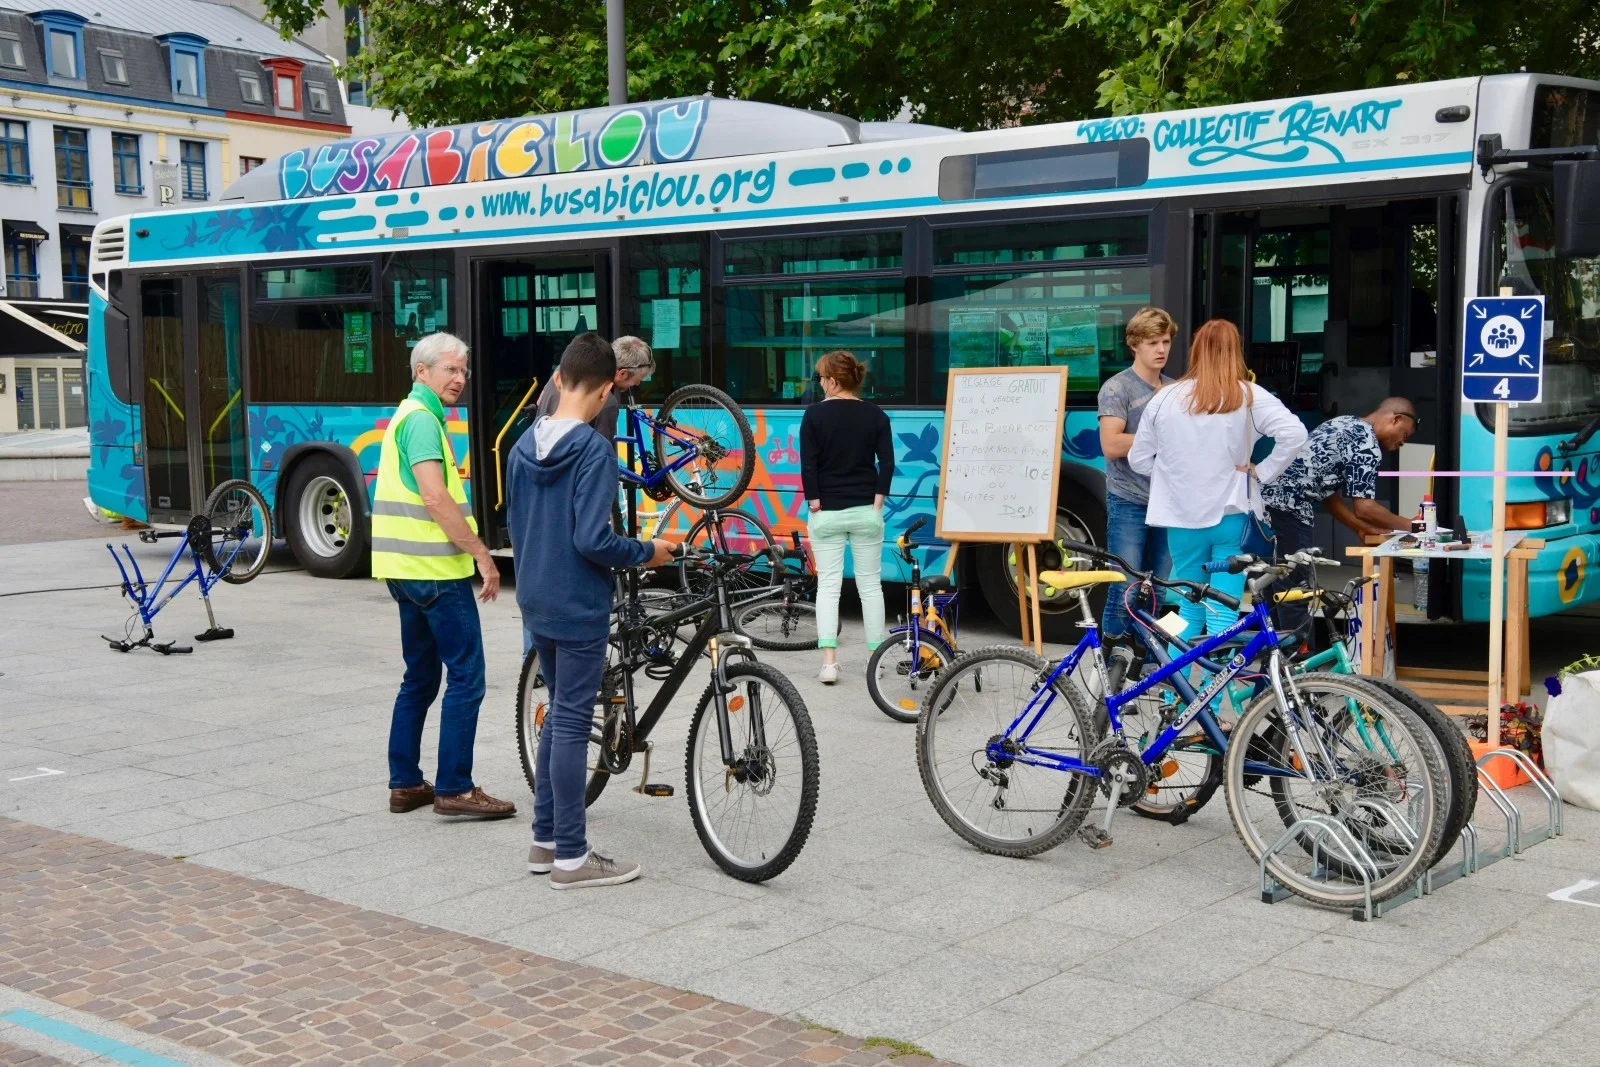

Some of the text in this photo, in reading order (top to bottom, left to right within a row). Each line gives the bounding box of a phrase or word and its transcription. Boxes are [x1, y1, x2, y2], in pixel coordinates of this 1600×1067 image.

[1154, 110, 1275, 152] COLLECTIF
[1280, 99, 1402, 146] RENART
[1352, 132, 1452, 150] GX 317
[482, 161, 776, 217] www.busabiclou.org
[1008, 378, 1048, 394] GRATUIT
[1493, 378, 1510, 398] 4
[993, 396, 1022, 404] VENDRE
[955, 446, 969, 456] ET
[971, 445, 994, 454] POUR
[996, 445, 1017, 455] NOUS
[989, 481, 1005, 489] OU
[963, 492, 995, 502] FAITES
[1003, 505, 1037, 516] DON
